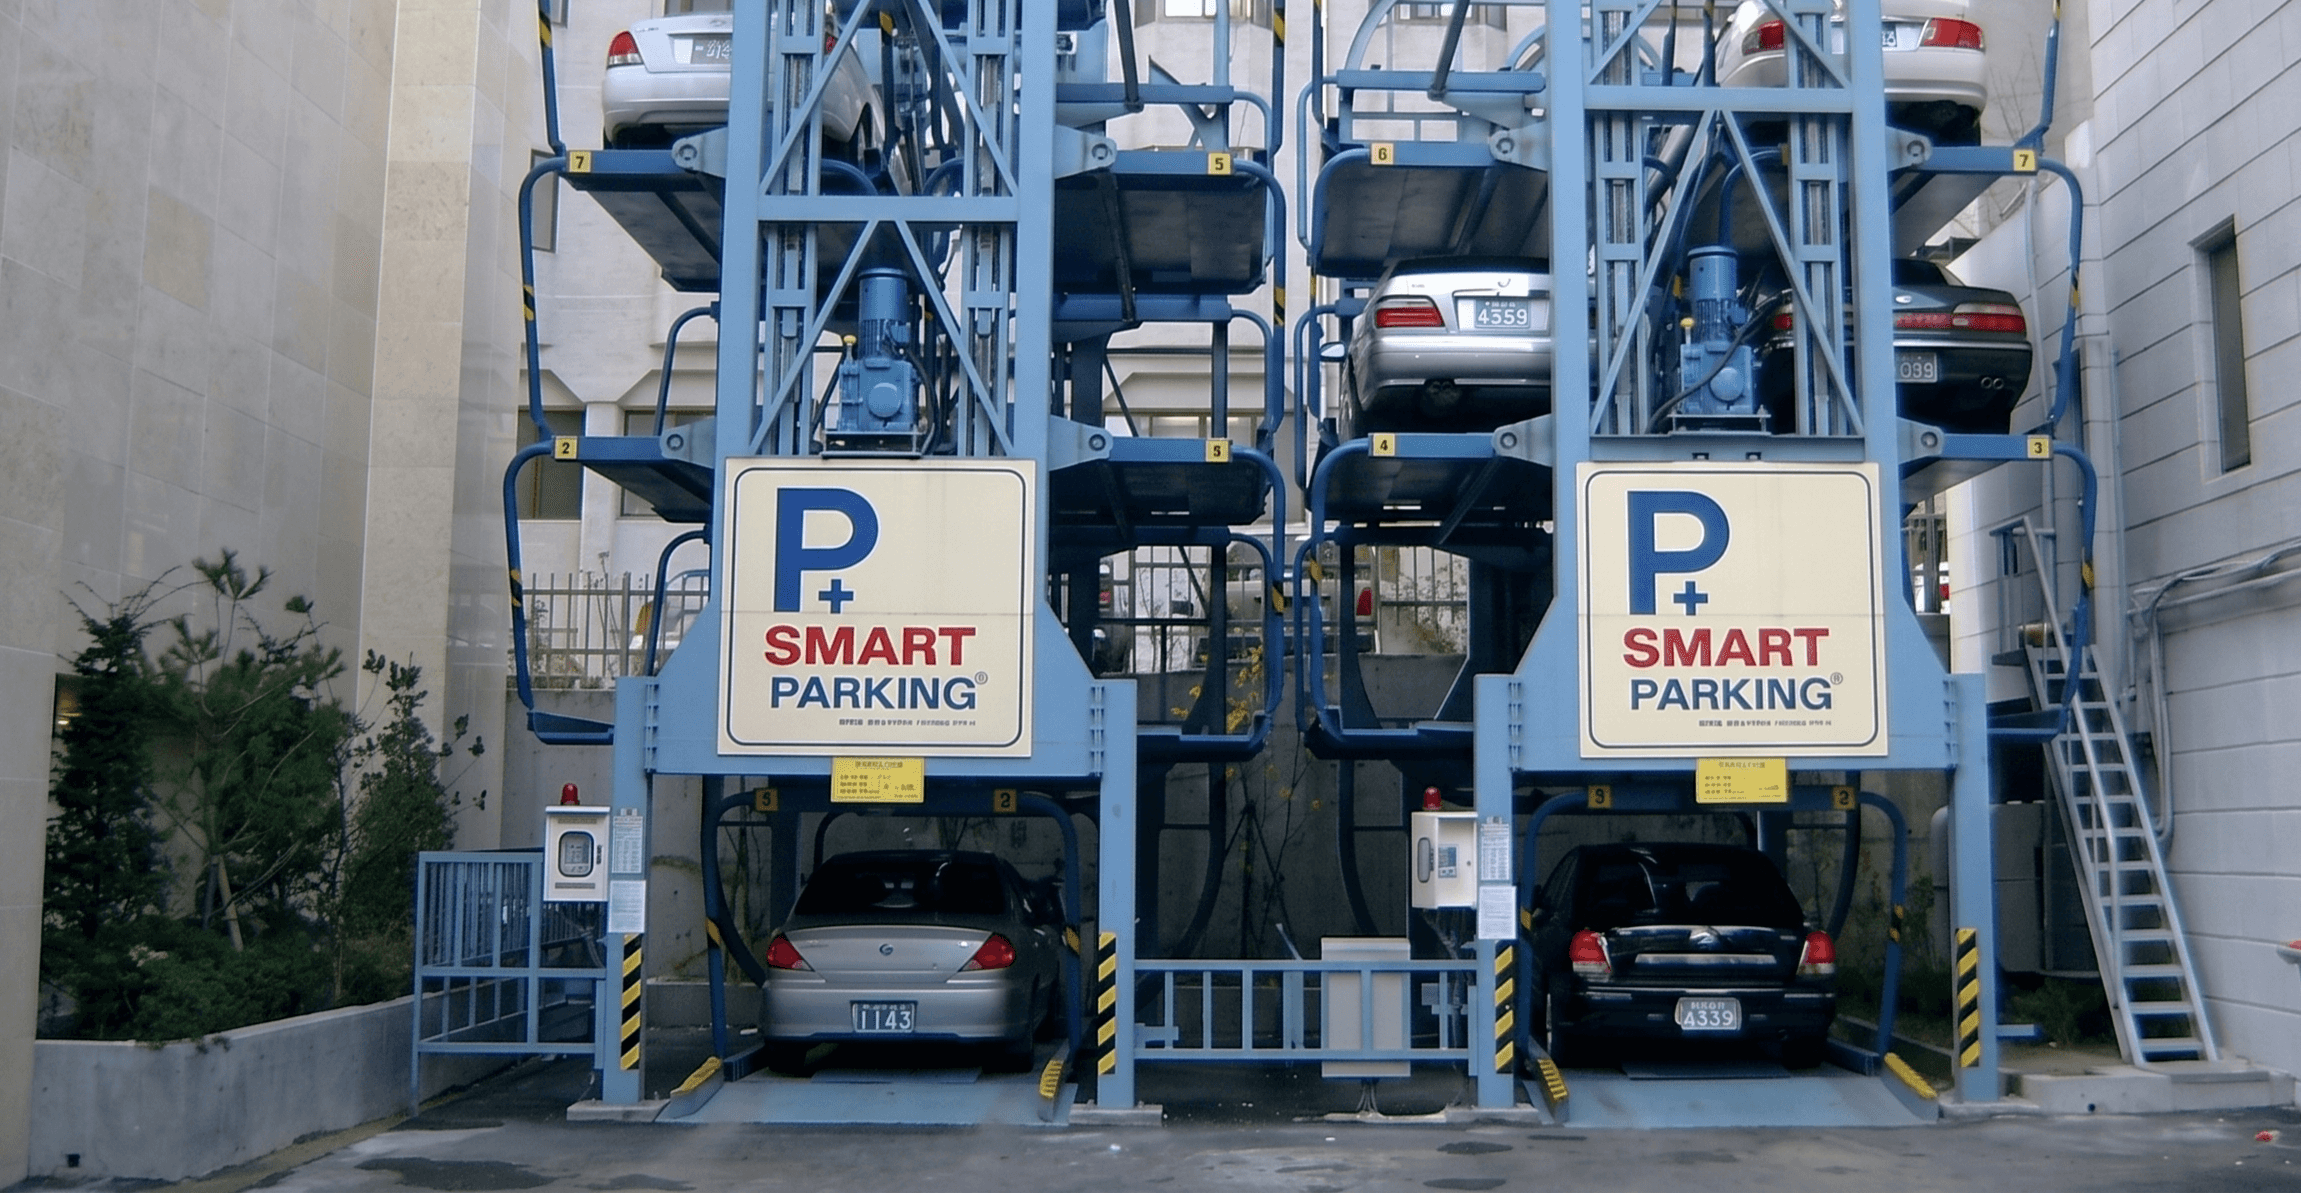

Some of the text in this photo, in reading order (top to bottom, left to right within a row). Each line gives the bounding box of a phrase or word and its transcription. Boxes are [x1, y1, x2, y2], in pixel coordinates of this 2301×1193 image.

[1378, 147, 1388, 161] 6
[2019, 153, 2029, 167] 7
[575, 155, 585, 169] 7
[1214, 157, 1224, 171] 5
[561, 441, 571, 455] 2
[1379, 439, 1389, 451] 4
[2034, 441, 2043, 454] 3
[763, 624, 977, 667] SMART
[1622, 627, 1830, 669] SMART
[999, 792, 1011, 808] 2
[861, 1010, 911, 1030] 1143
[1683, 1010, 1734, 1027] 4339
